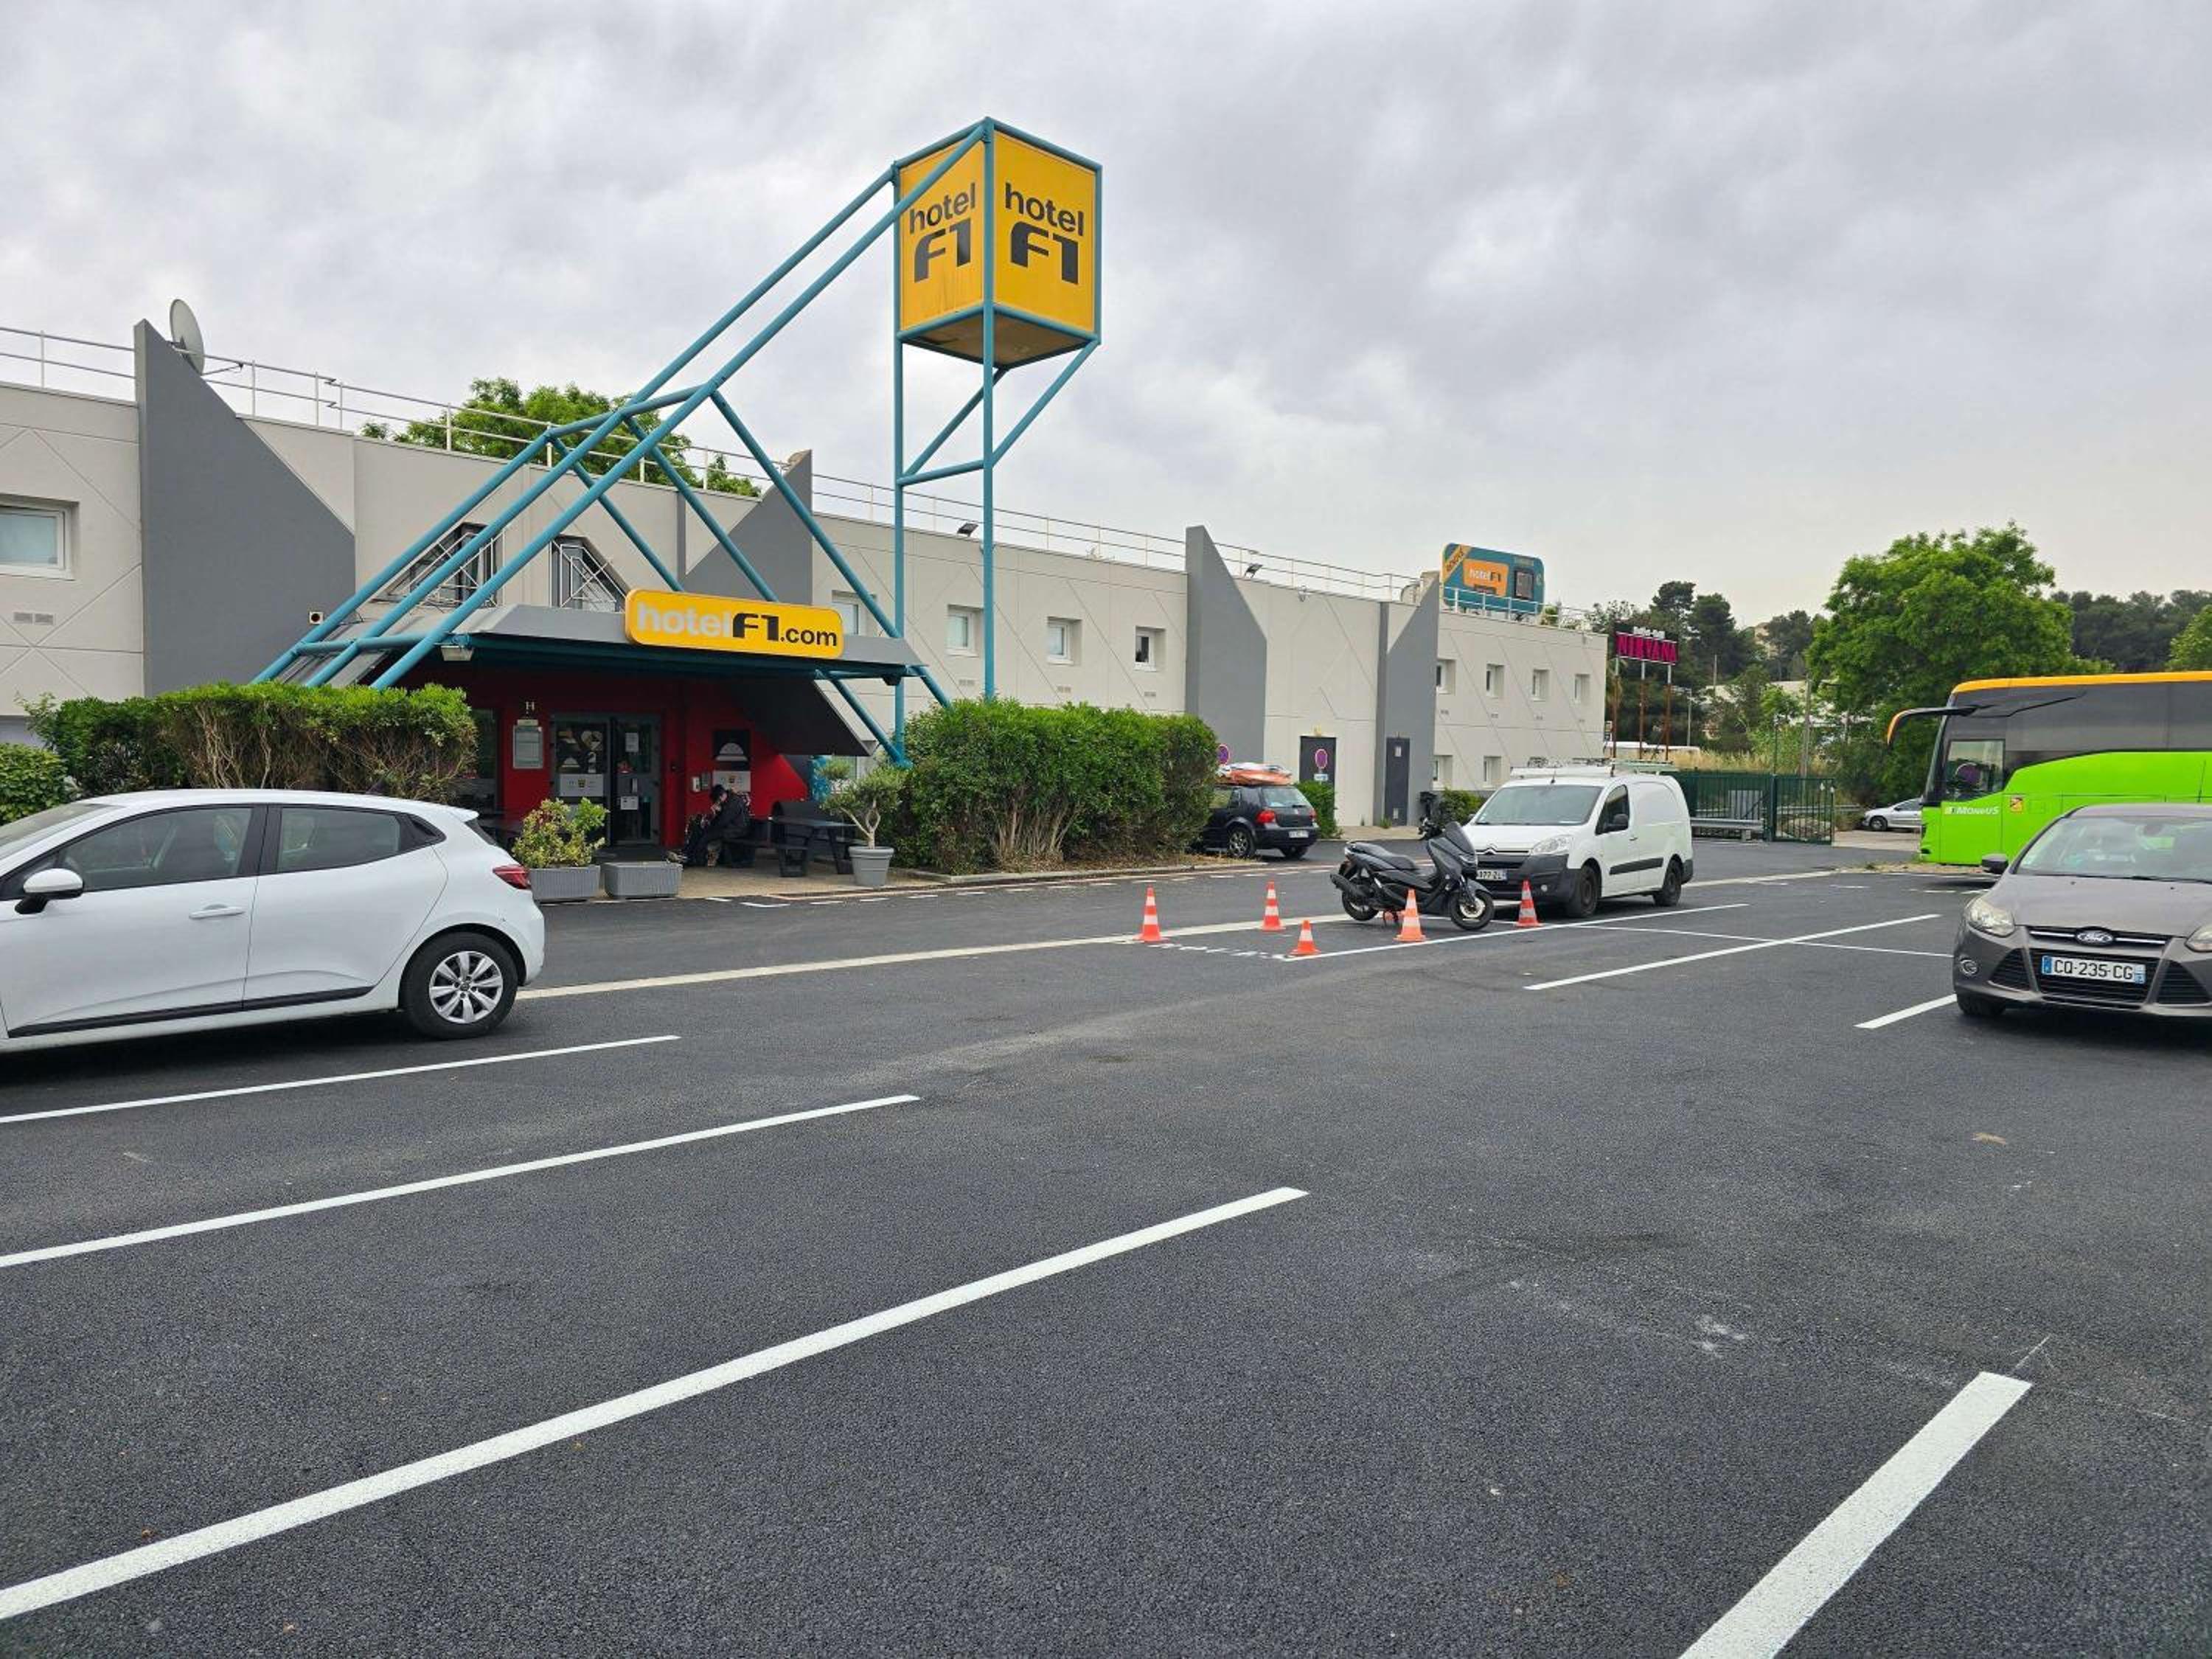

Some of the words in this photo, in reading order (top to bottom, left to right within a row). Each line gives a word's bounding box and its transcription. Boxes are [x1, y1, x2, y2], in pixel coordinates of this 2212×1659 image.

[909, 182, 975, 235] hotel
[1005, 182, 1085, 237] hotel
[914, 218, 971, 283] F1
[1010, 220, 1079, 285] F1
[2054, 959, 2133, 980] CQ-235-CG
